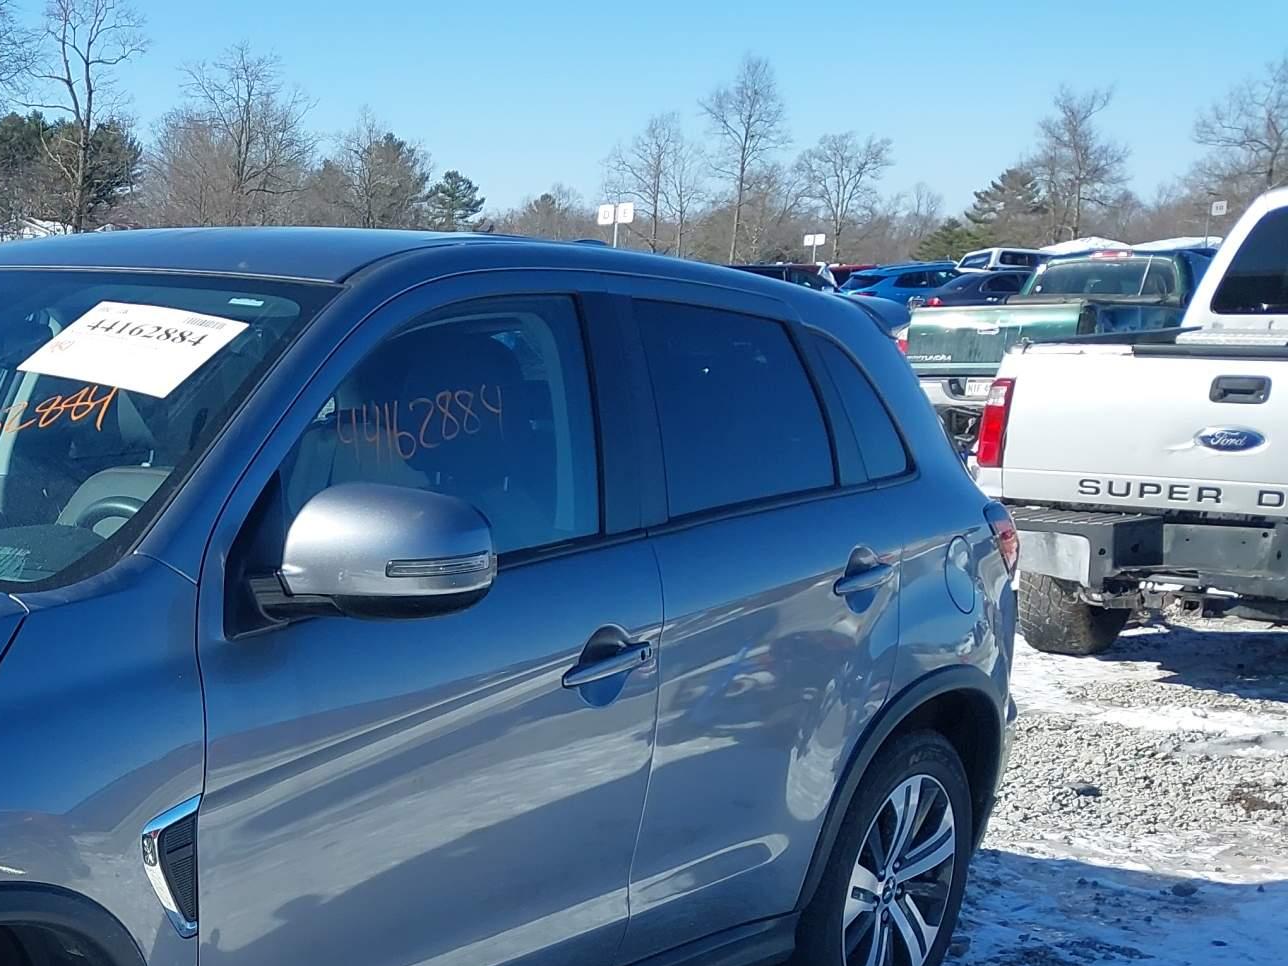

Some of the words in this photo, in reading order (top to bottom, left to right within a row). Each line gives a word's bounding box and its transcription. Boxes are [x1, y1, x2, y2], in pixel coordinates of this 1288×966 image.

[87, 318, 209, 347] 44162884
[337, 384, 505, 464] 44162884
[1078, 478, 1222, 504] SUPER
